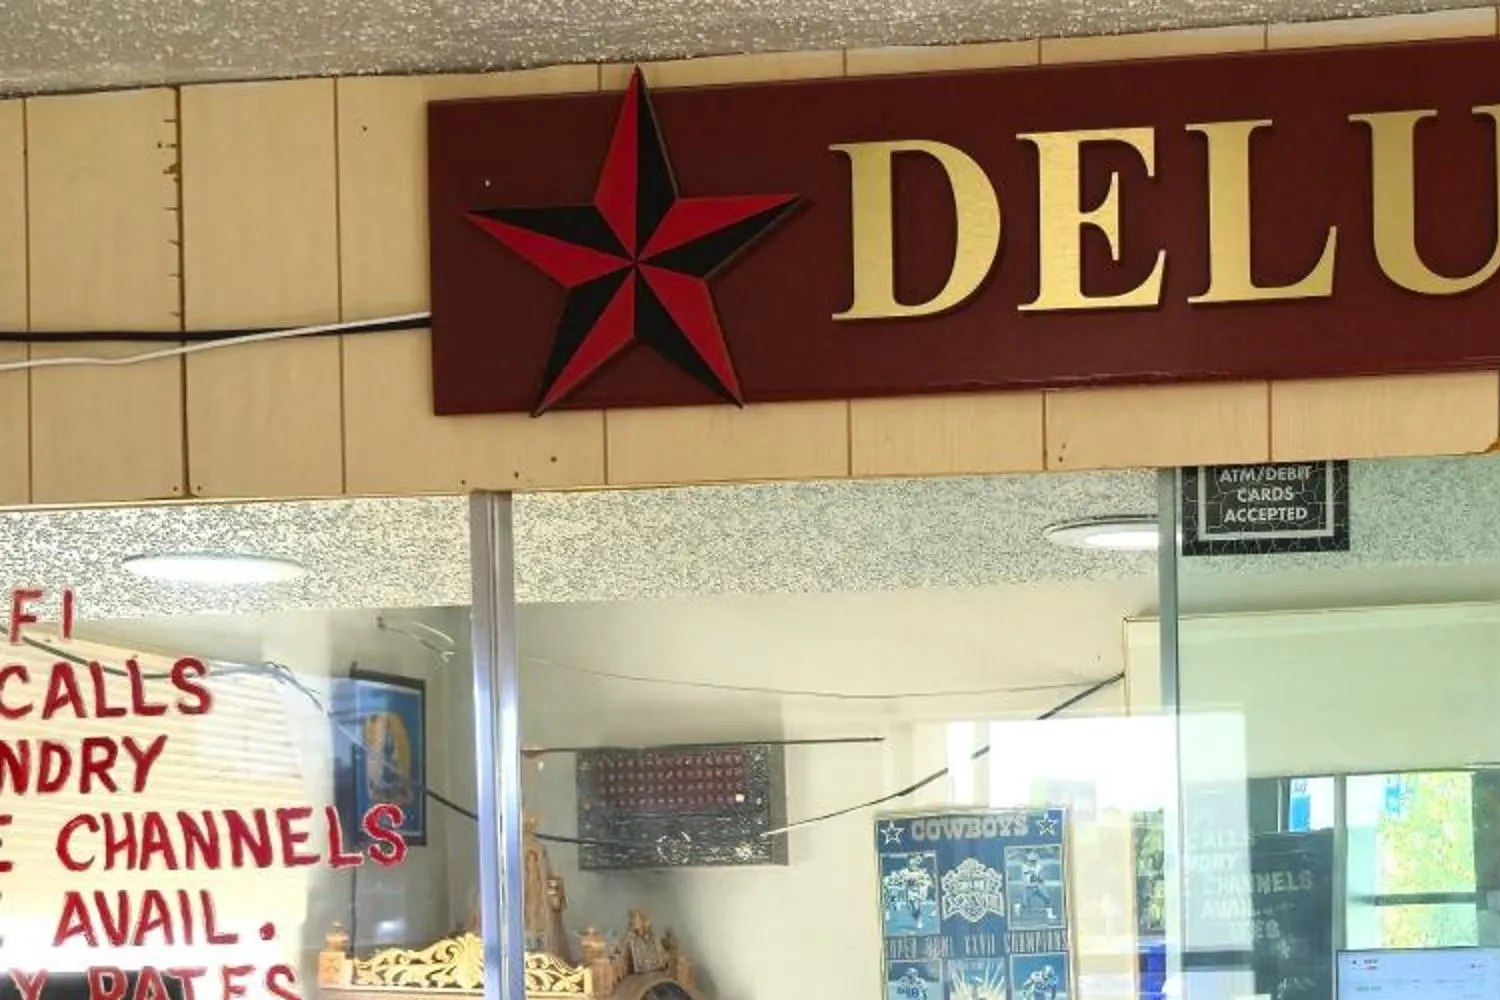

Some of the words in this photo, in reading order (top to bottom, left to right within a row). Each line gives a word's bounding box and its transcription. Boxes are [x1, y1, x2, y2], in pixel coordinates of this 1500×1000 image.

[1220, 465, 1312, 483] ATM/DEBIT
[1237, 486, 1295, 502] CARDS
[1224, 507, 1308, 523] ACCEPTED
[0, 655, 214, 720] CALLS
[55, 801, 408, 872] CHANNELS
[911, 814, 1029, 841] COWBOYS
[52, 890, 276, 947] AVAIL.
